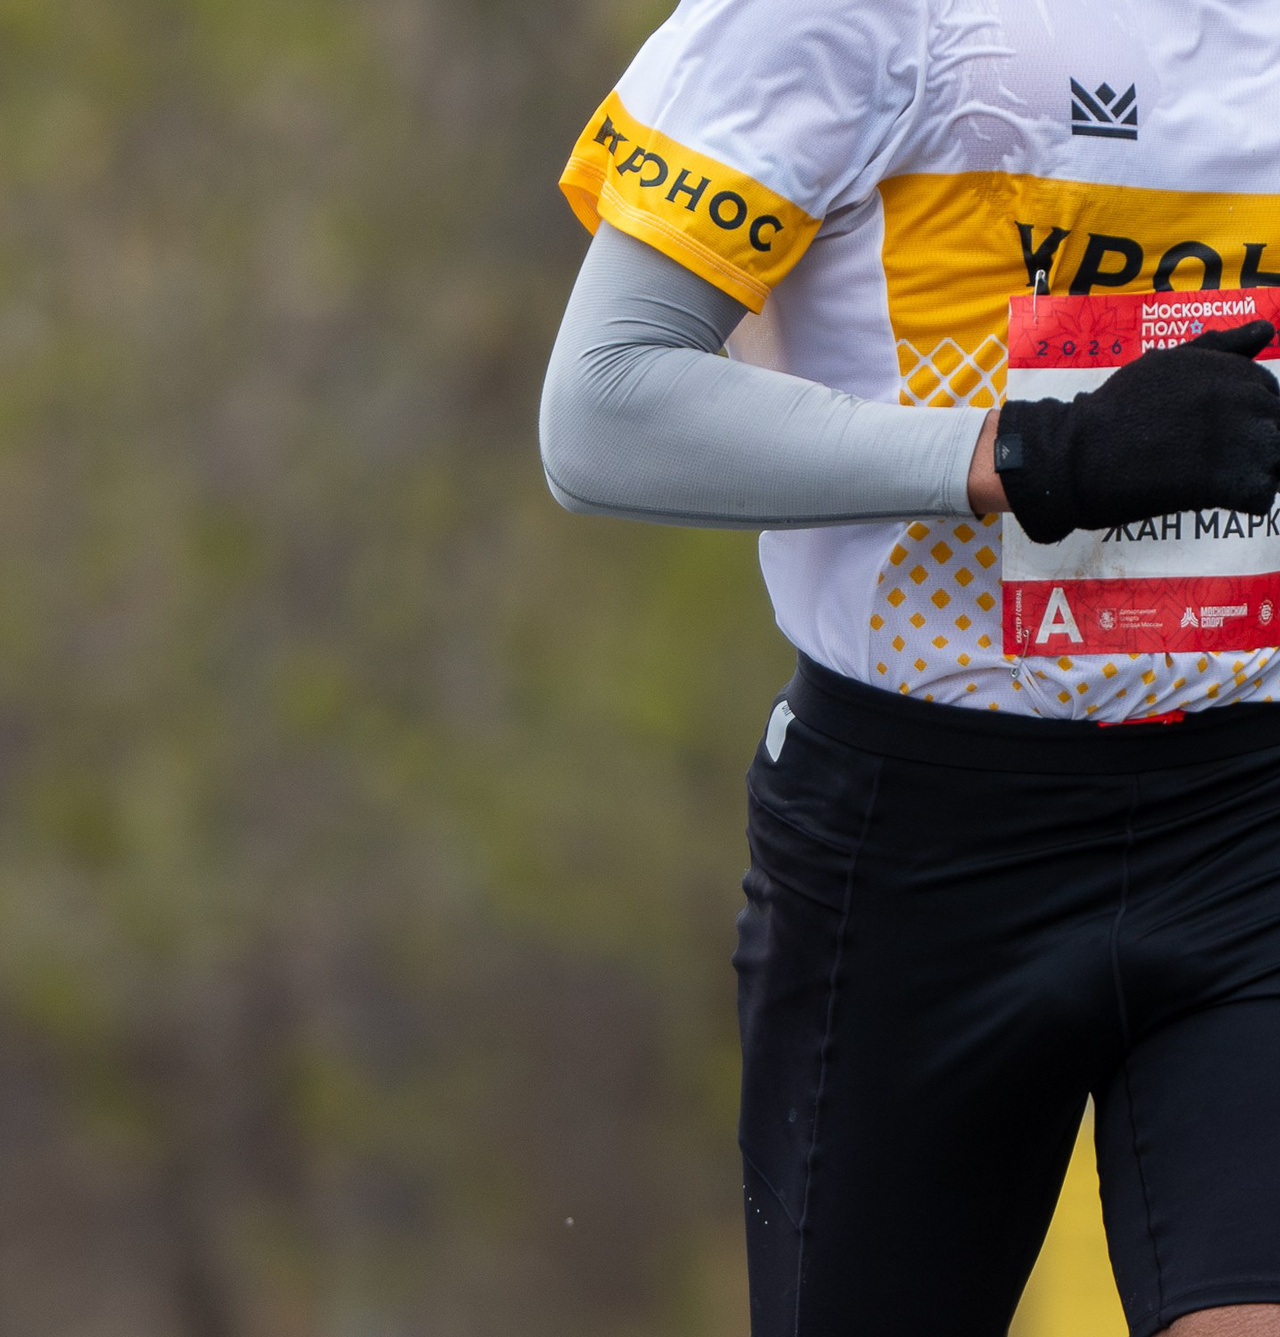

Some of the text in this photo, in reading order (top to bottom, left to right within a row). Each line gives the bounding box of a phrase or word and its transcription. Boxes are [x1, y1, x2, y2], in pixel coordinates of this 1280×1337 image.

[1142, 296, 1256, 319] МОСКОВСКИЙ
[1142, 320, 1189, 337] ПОЛУ
[1037, 339, 1122, 356] 2026
[1195, 507, 1280, 540] МАРК
[1035, 587, 1084, 644] A
